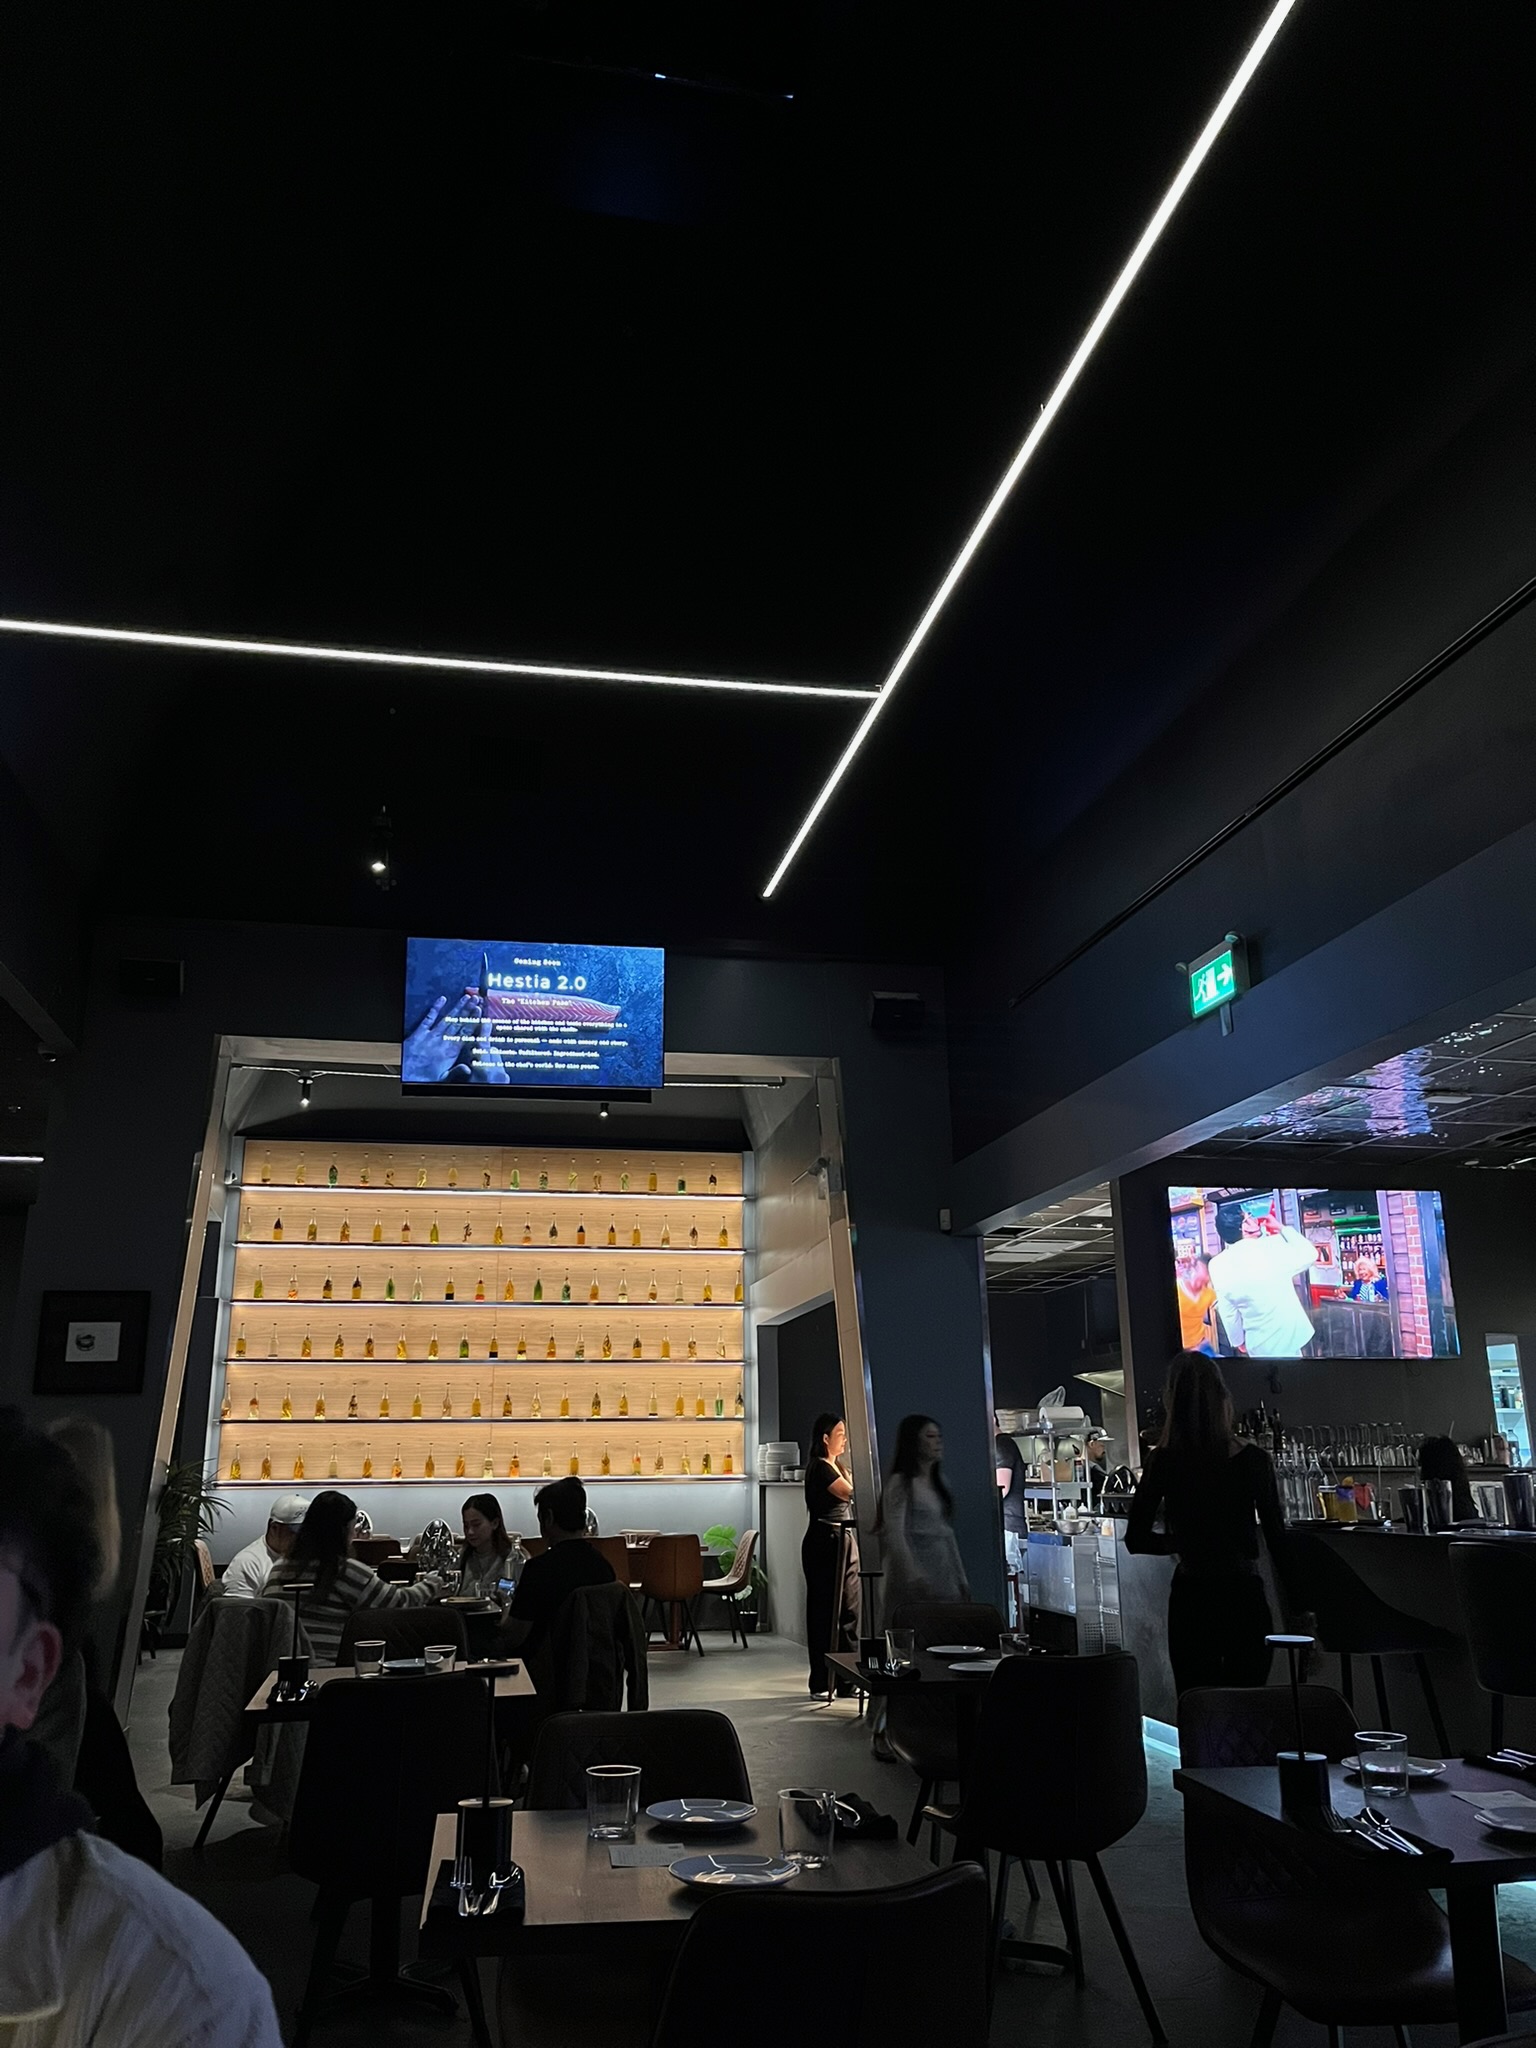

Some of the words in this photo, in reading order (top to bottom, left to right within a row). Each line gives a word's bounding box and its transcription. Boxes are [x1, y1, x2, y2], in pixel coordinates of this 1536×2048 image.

[514, 958, 542, 966] Coming
[488, 972, 551, 989] Hestia
[557, 975, 587, 990] 2.0
